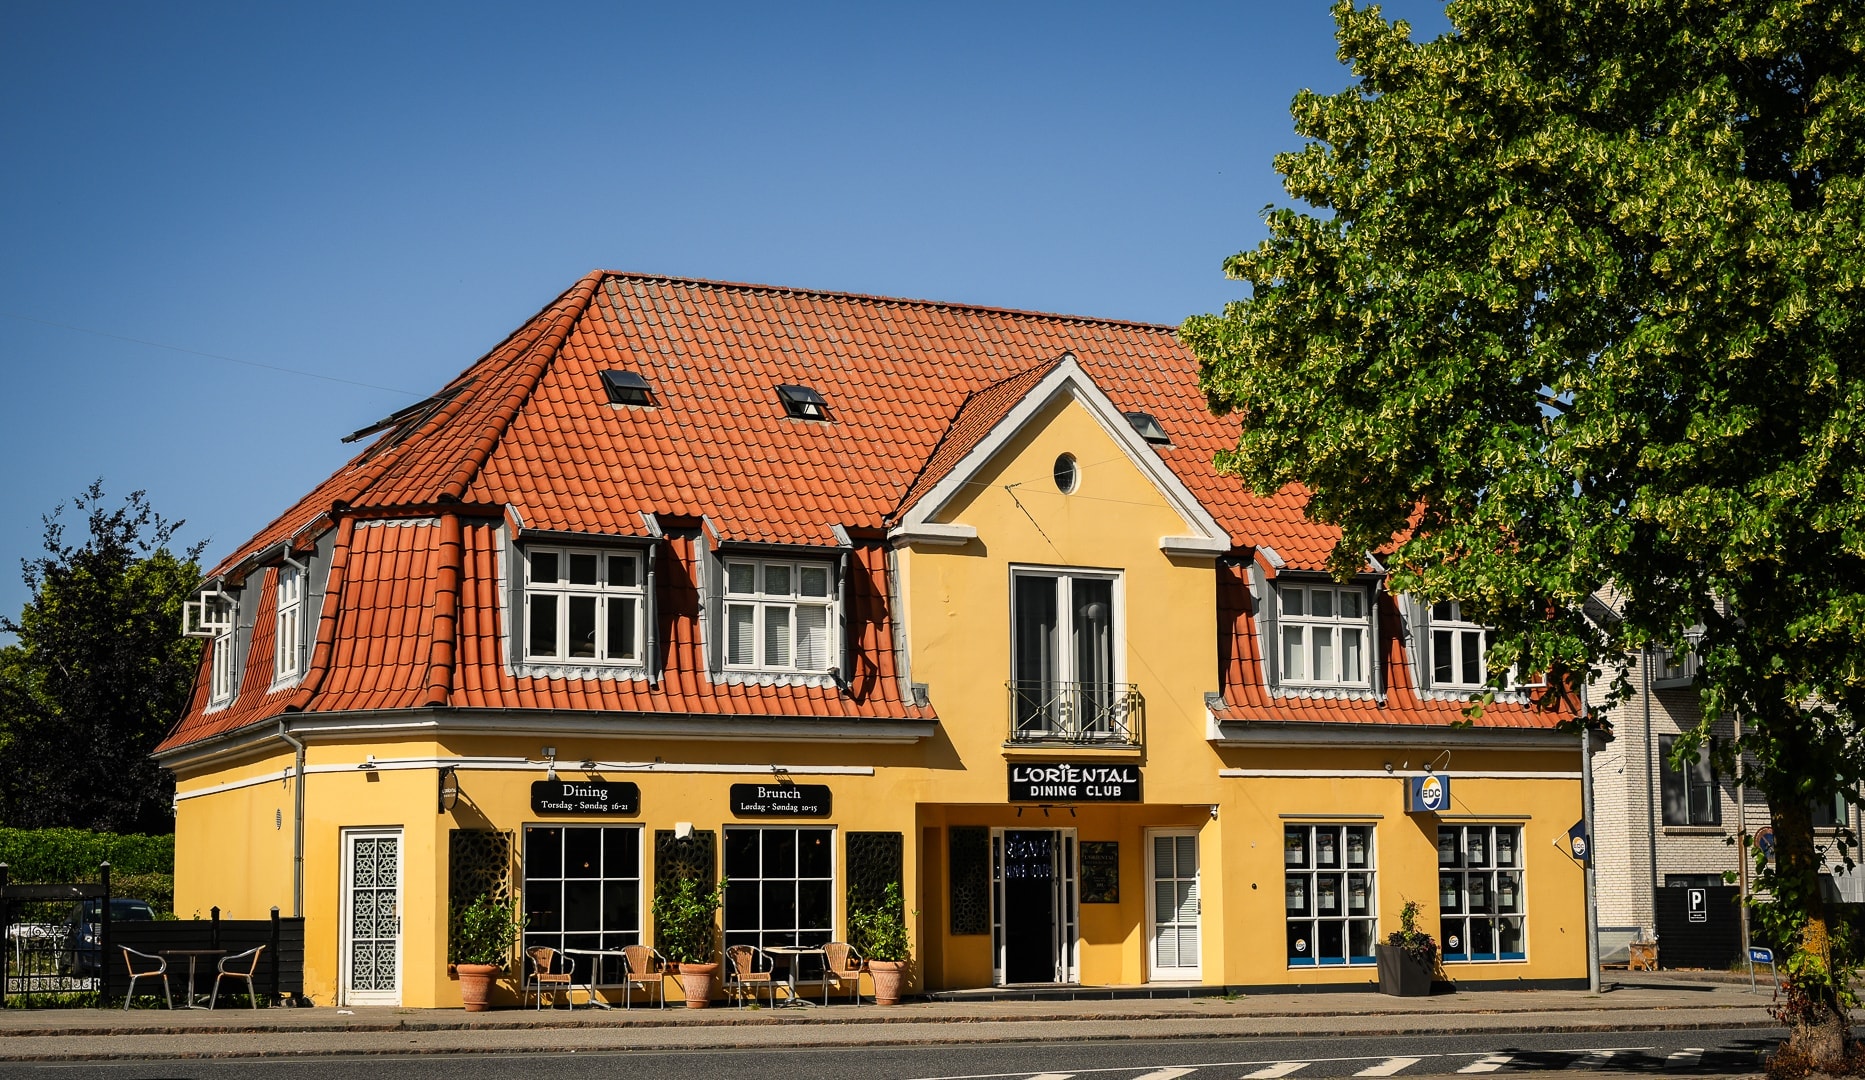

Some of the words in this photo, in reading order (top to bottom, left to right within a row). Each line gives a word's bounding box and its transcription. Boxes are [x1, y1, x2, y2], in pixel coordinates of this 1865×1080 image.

[1013, 764, 1137, 783] L'ORÏENTAL
[563, 784, 608, 800] Dining
[757, 786, 801, 799] Brunch
[1030, 785, 1077, 797] DINING
[1086, 785, 1122, 797] CLUB
[1422, 788, 1441, 799] EDC
[541, 800, 573, 811] Torsdag
[579, 801, 608, 812] Søndag
[611, 802, 628, 810] 16-21
[740, 802, 766, 813] Lørdag
[772, 802, 799, 813] Søndag
[1692, 891, 1702, 910] P
